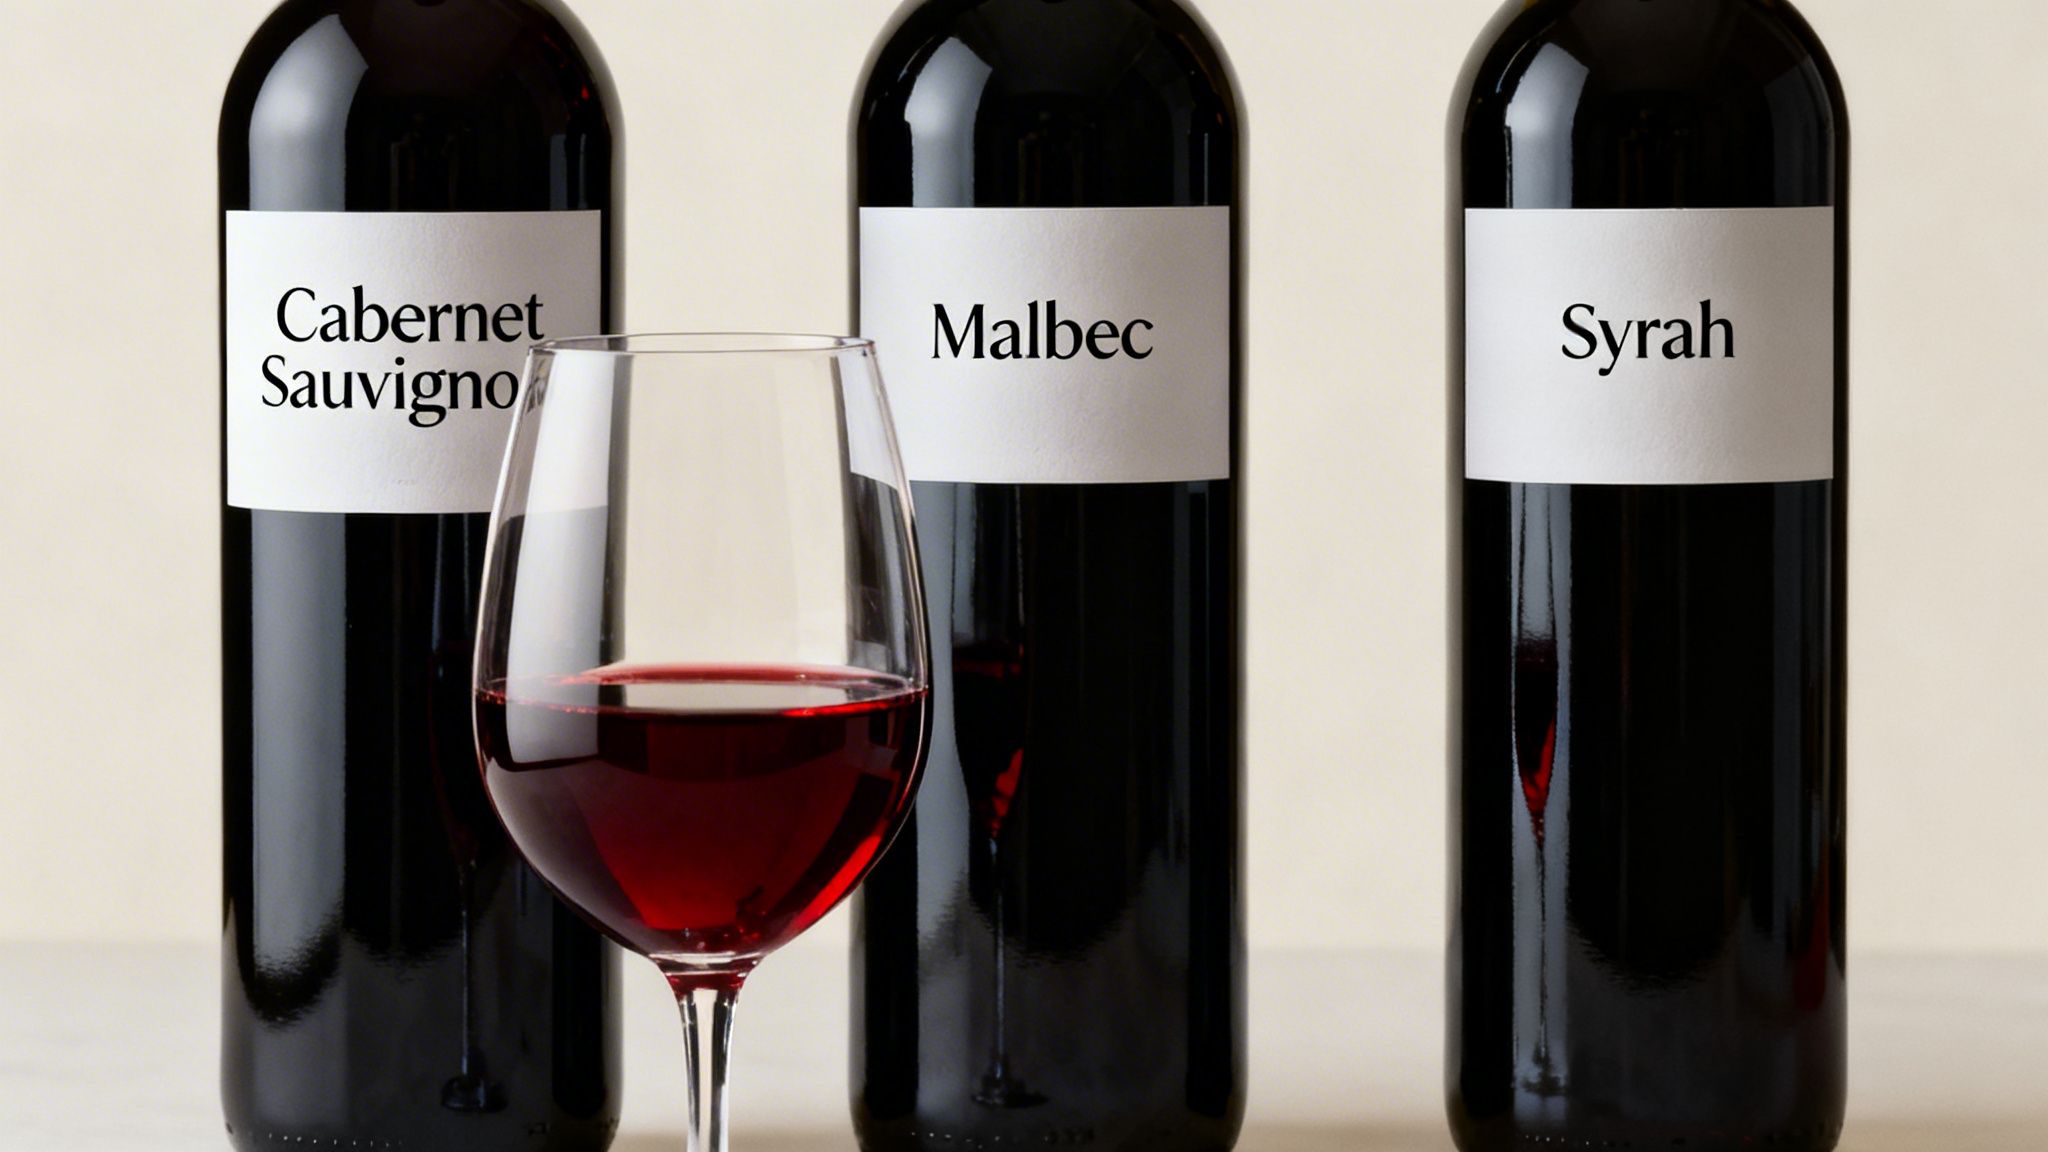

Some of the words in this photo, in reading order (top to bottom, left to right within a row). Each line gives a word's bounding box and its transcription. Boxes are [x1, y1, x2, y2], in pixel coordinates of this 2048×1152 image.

[277, 285, 545, 343] Cabernet
[932, 299, 1154, 360] Malbec
[1562, 299, 1736, 377] Syrah
[261, 354, 522, 428] Sauvigno
